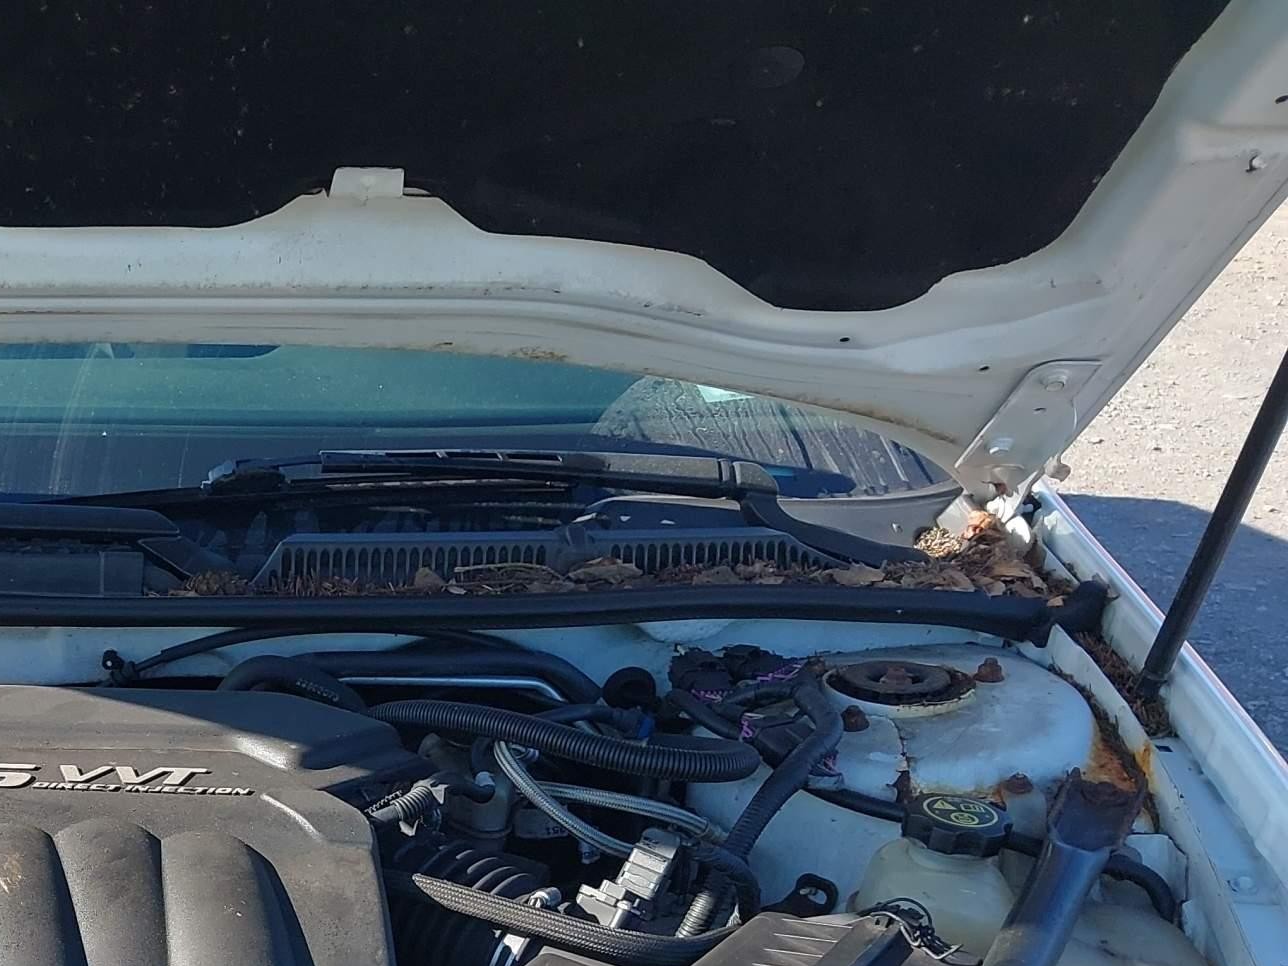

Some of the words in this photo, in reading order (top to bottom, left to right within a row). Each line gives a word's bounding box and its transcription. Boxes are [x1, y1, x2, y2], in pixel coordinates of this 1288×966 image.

[60, 764, 209, 785] VVT
[34, 781, 123, 792] DIRECT
[125, 783, 252, 796] INJECTION
